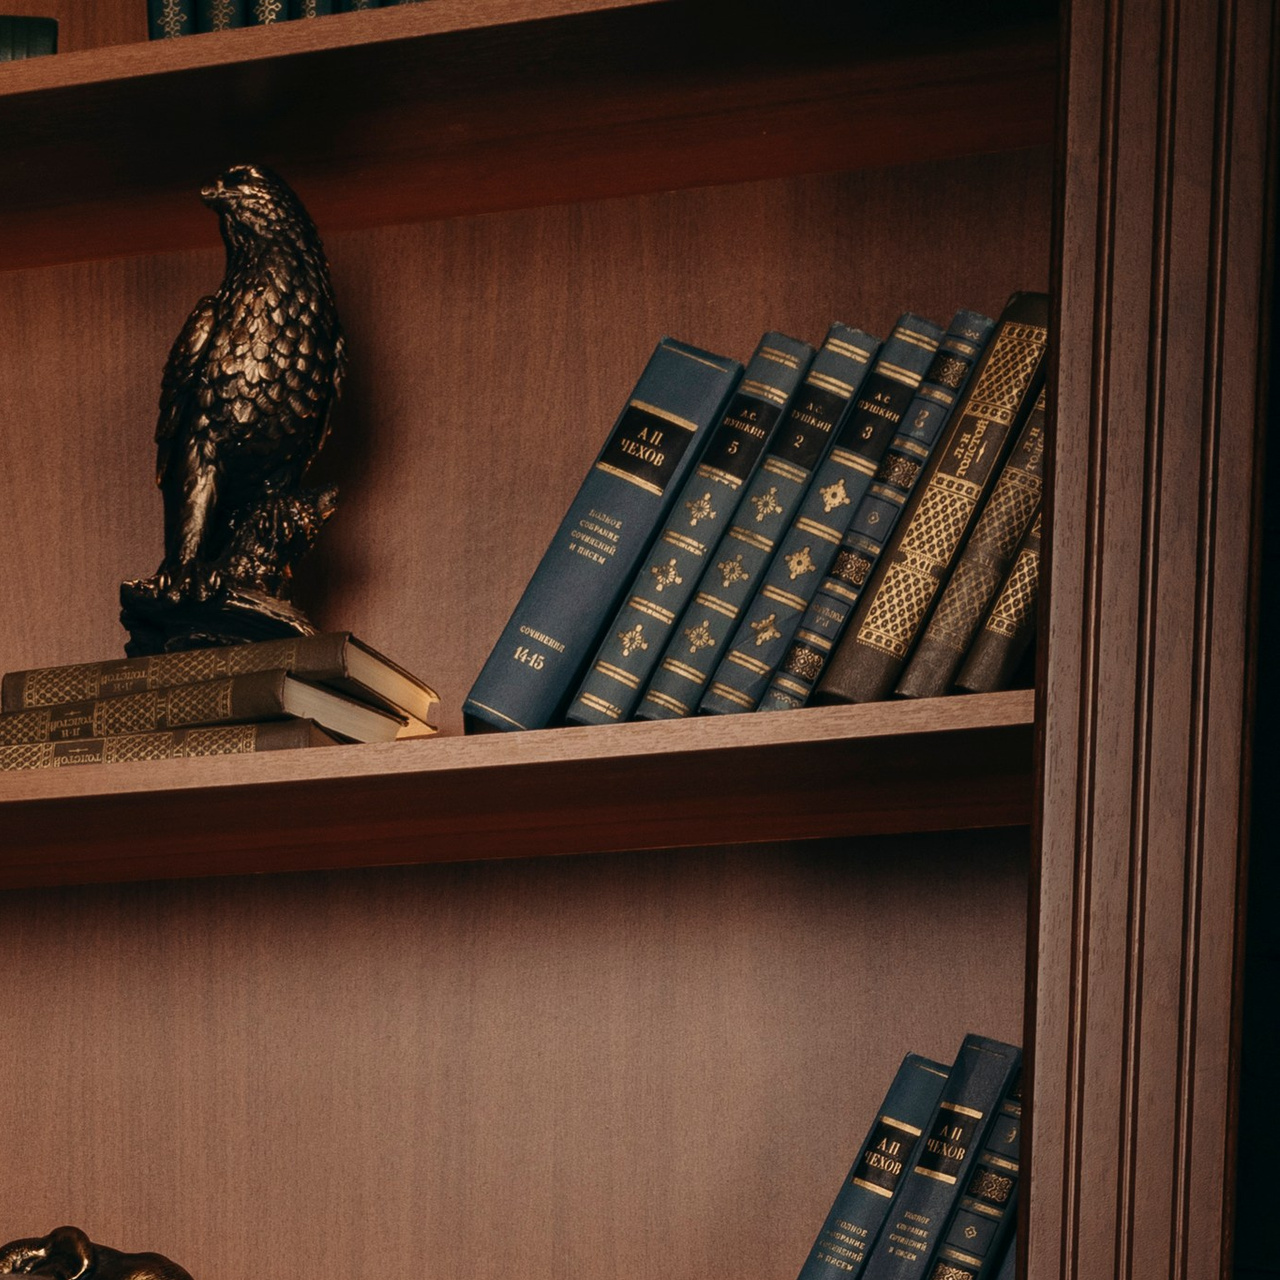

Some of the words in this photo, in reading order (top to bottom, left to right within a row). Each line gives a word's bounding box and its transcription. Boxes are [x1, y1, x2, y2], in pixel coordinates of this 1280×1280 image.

[793, 434, 806, 450] 2
[861, 425, 875, 441] 3
[621, 438, 665, 468] ЧЕХОВ
[727, 440, 740, 455] 5
[957, 417, 989, 478] ТОЛСТОЙ
[513, 645, 546, 672] 14-15
[926, 1137, 967, 1161] ЧЕХОВ
[864, 1150, 903, 1176] ЧЕХОВ
